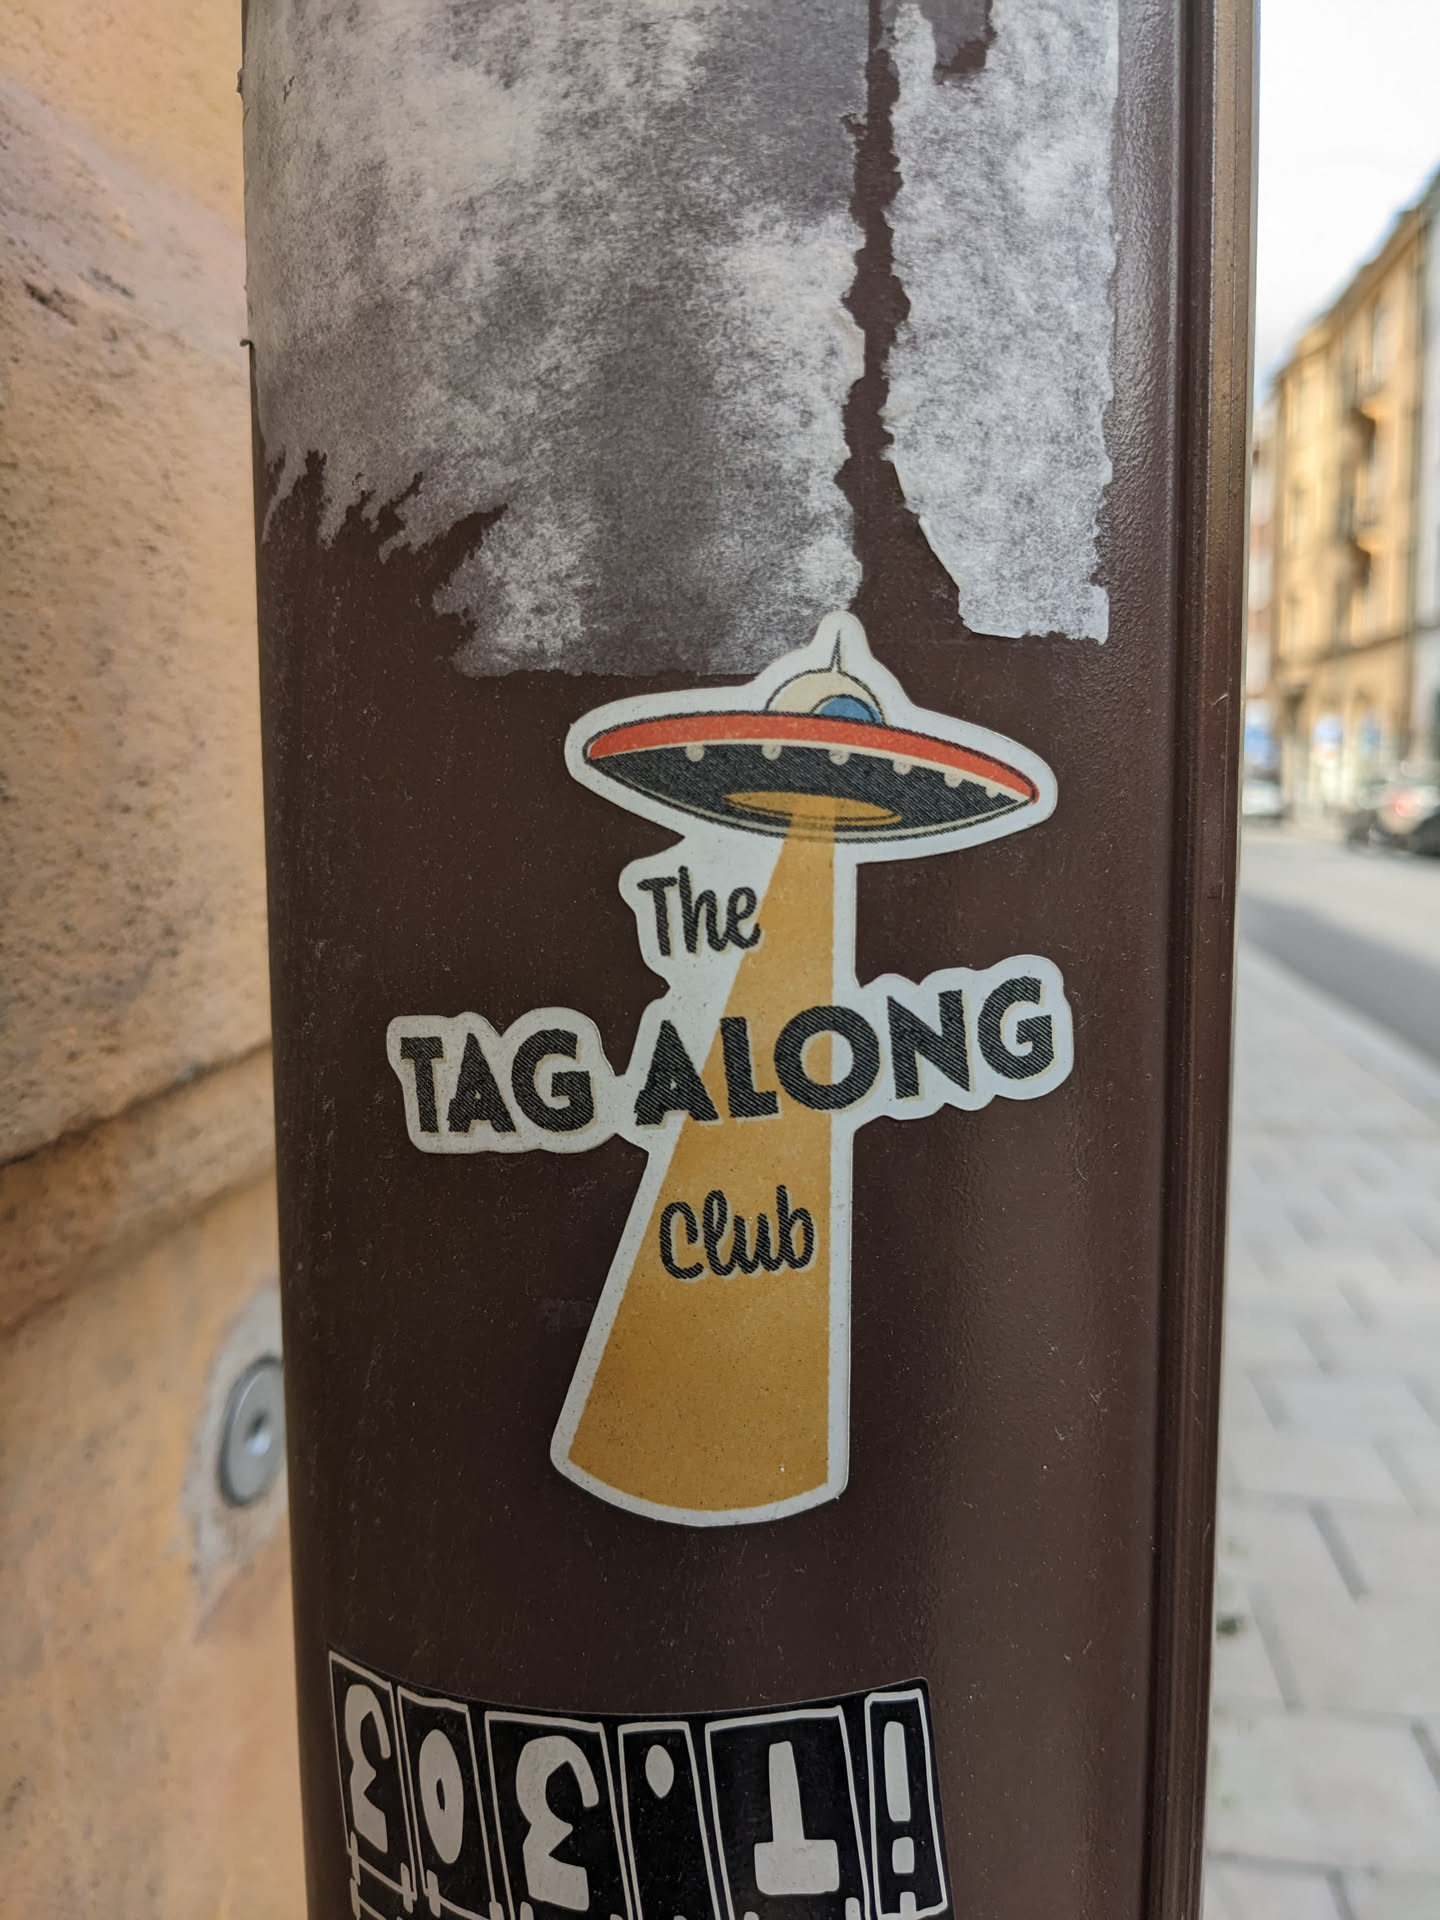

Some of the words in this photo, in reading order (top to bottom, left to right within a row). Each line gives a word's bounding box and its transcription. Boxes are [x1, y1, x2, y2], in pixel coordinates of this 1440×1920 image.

[638, 866, 761, 956] The
[400, 1028, 596, 1133] TAG
[635, 975, 1055, 1126] ALONG
[659, 1185, 815, 1280] Club
